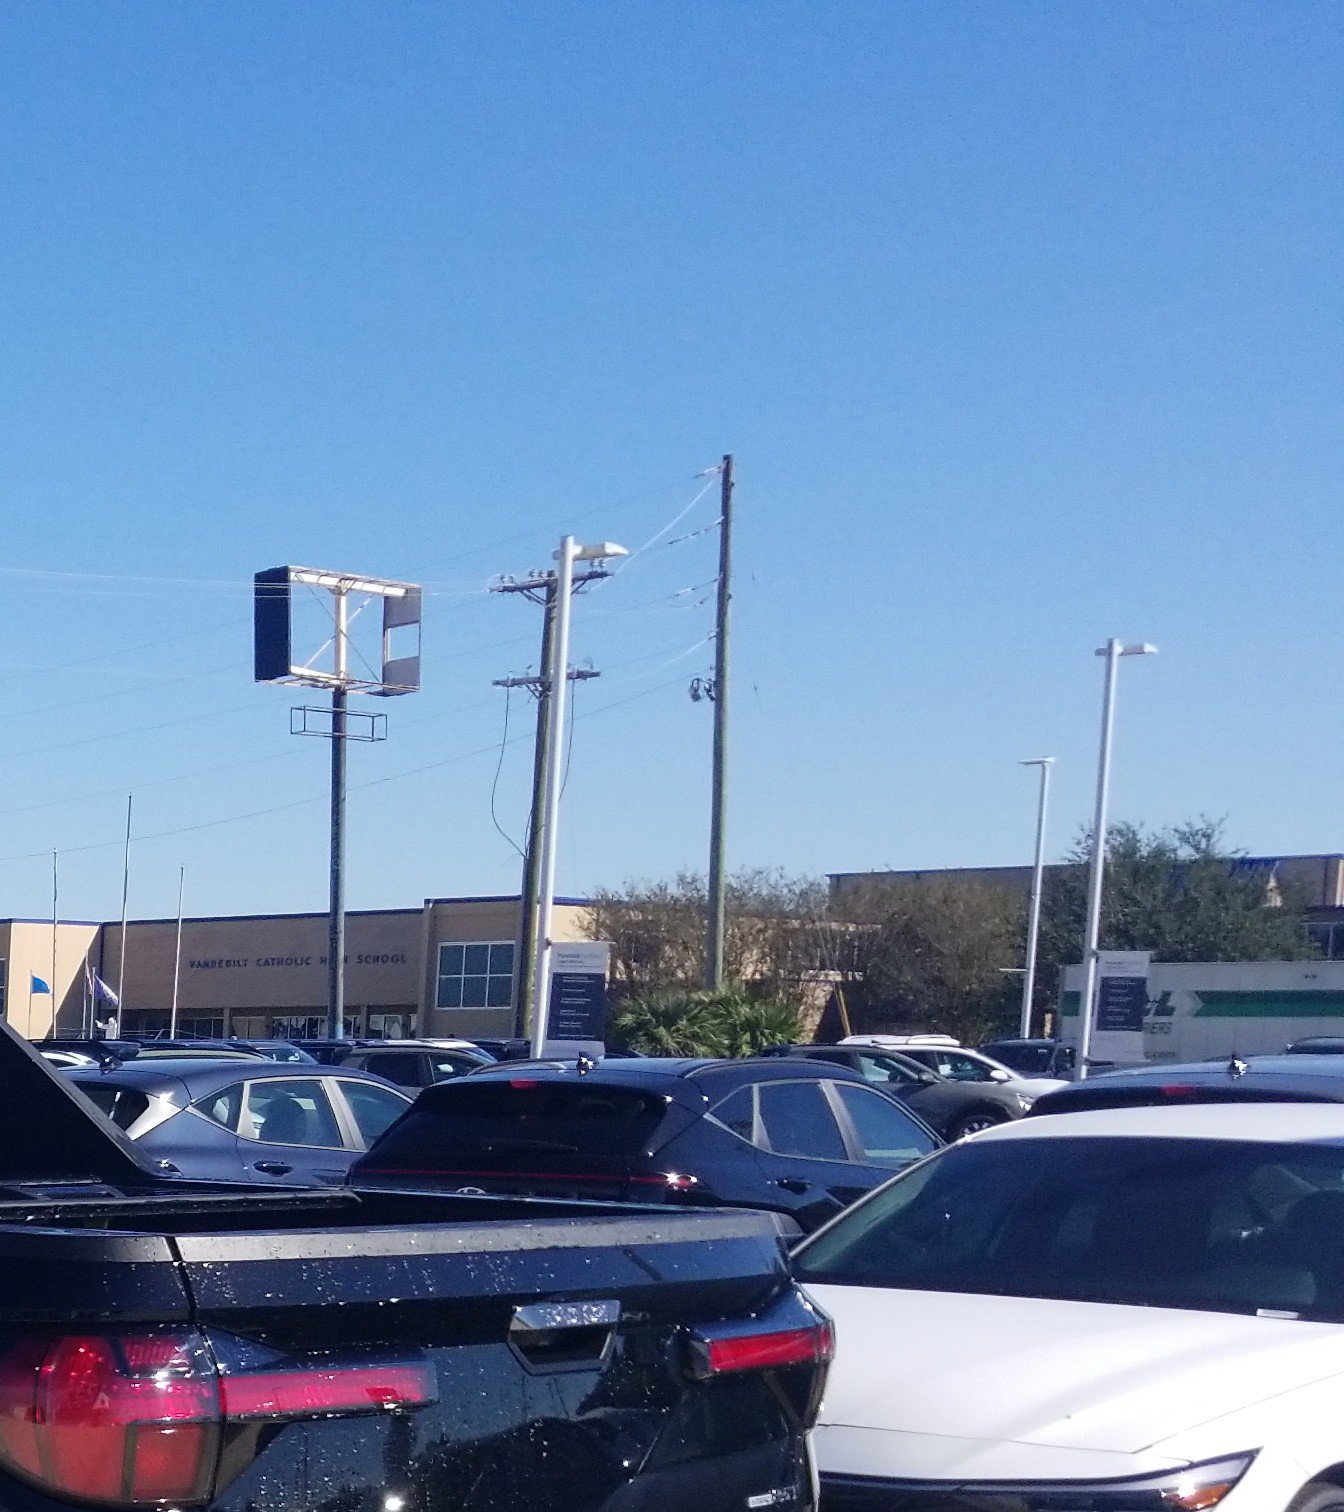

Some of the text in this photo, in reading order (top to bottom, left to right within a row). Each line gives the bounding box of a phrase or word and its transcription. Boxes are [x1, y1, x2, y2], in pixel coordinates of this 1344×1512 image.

[256, 956, 311, 967] CATHOLIC
[319, 957, 349, 966] HH
[356, 953, 407, 964] SCHOOL
